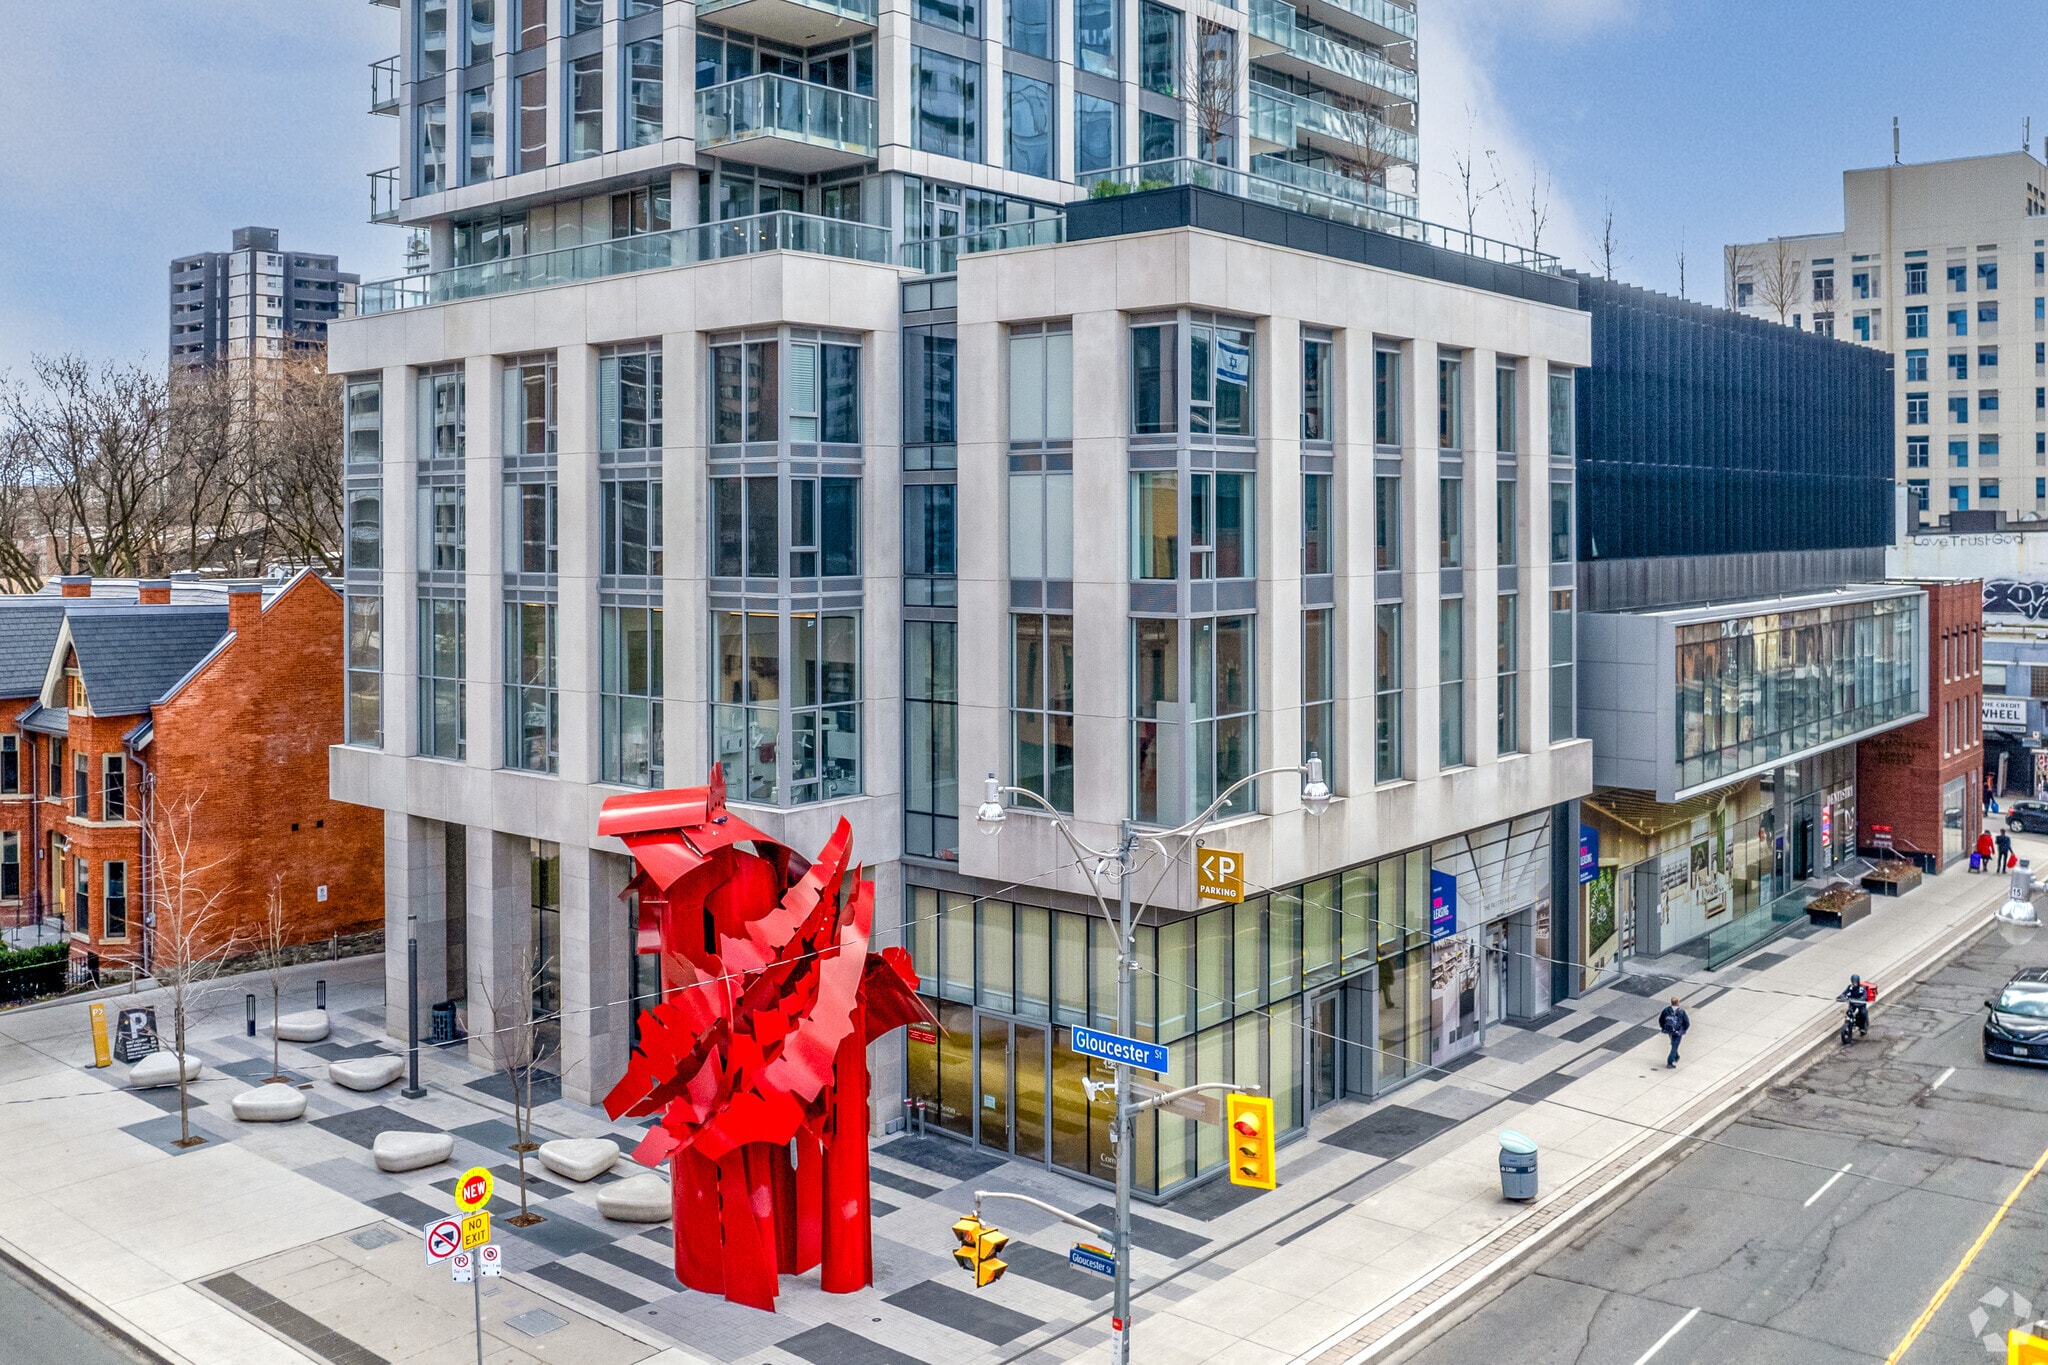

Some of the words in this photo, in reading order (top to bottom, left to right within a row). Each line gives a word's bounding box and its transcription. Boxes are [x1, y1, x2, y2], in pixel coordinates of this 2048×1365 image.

[1219, 856, 1235, 883] P
[1200, 885, 1237, 897] PARKING
[2012, 888, 2021, 897] 15
[129, 1012, 147, 1039] P
[1076, 1031, 1149, 1063] Gloucester
[1154, 1049, 1162, 1059] St
[463, 1181, 485, 1200] NEW
[468, 1218, 482, 1231] NO
[465, 1230, 485, 1245] EXIT
[1072, 1252, 1105, 1271] Gloucester
